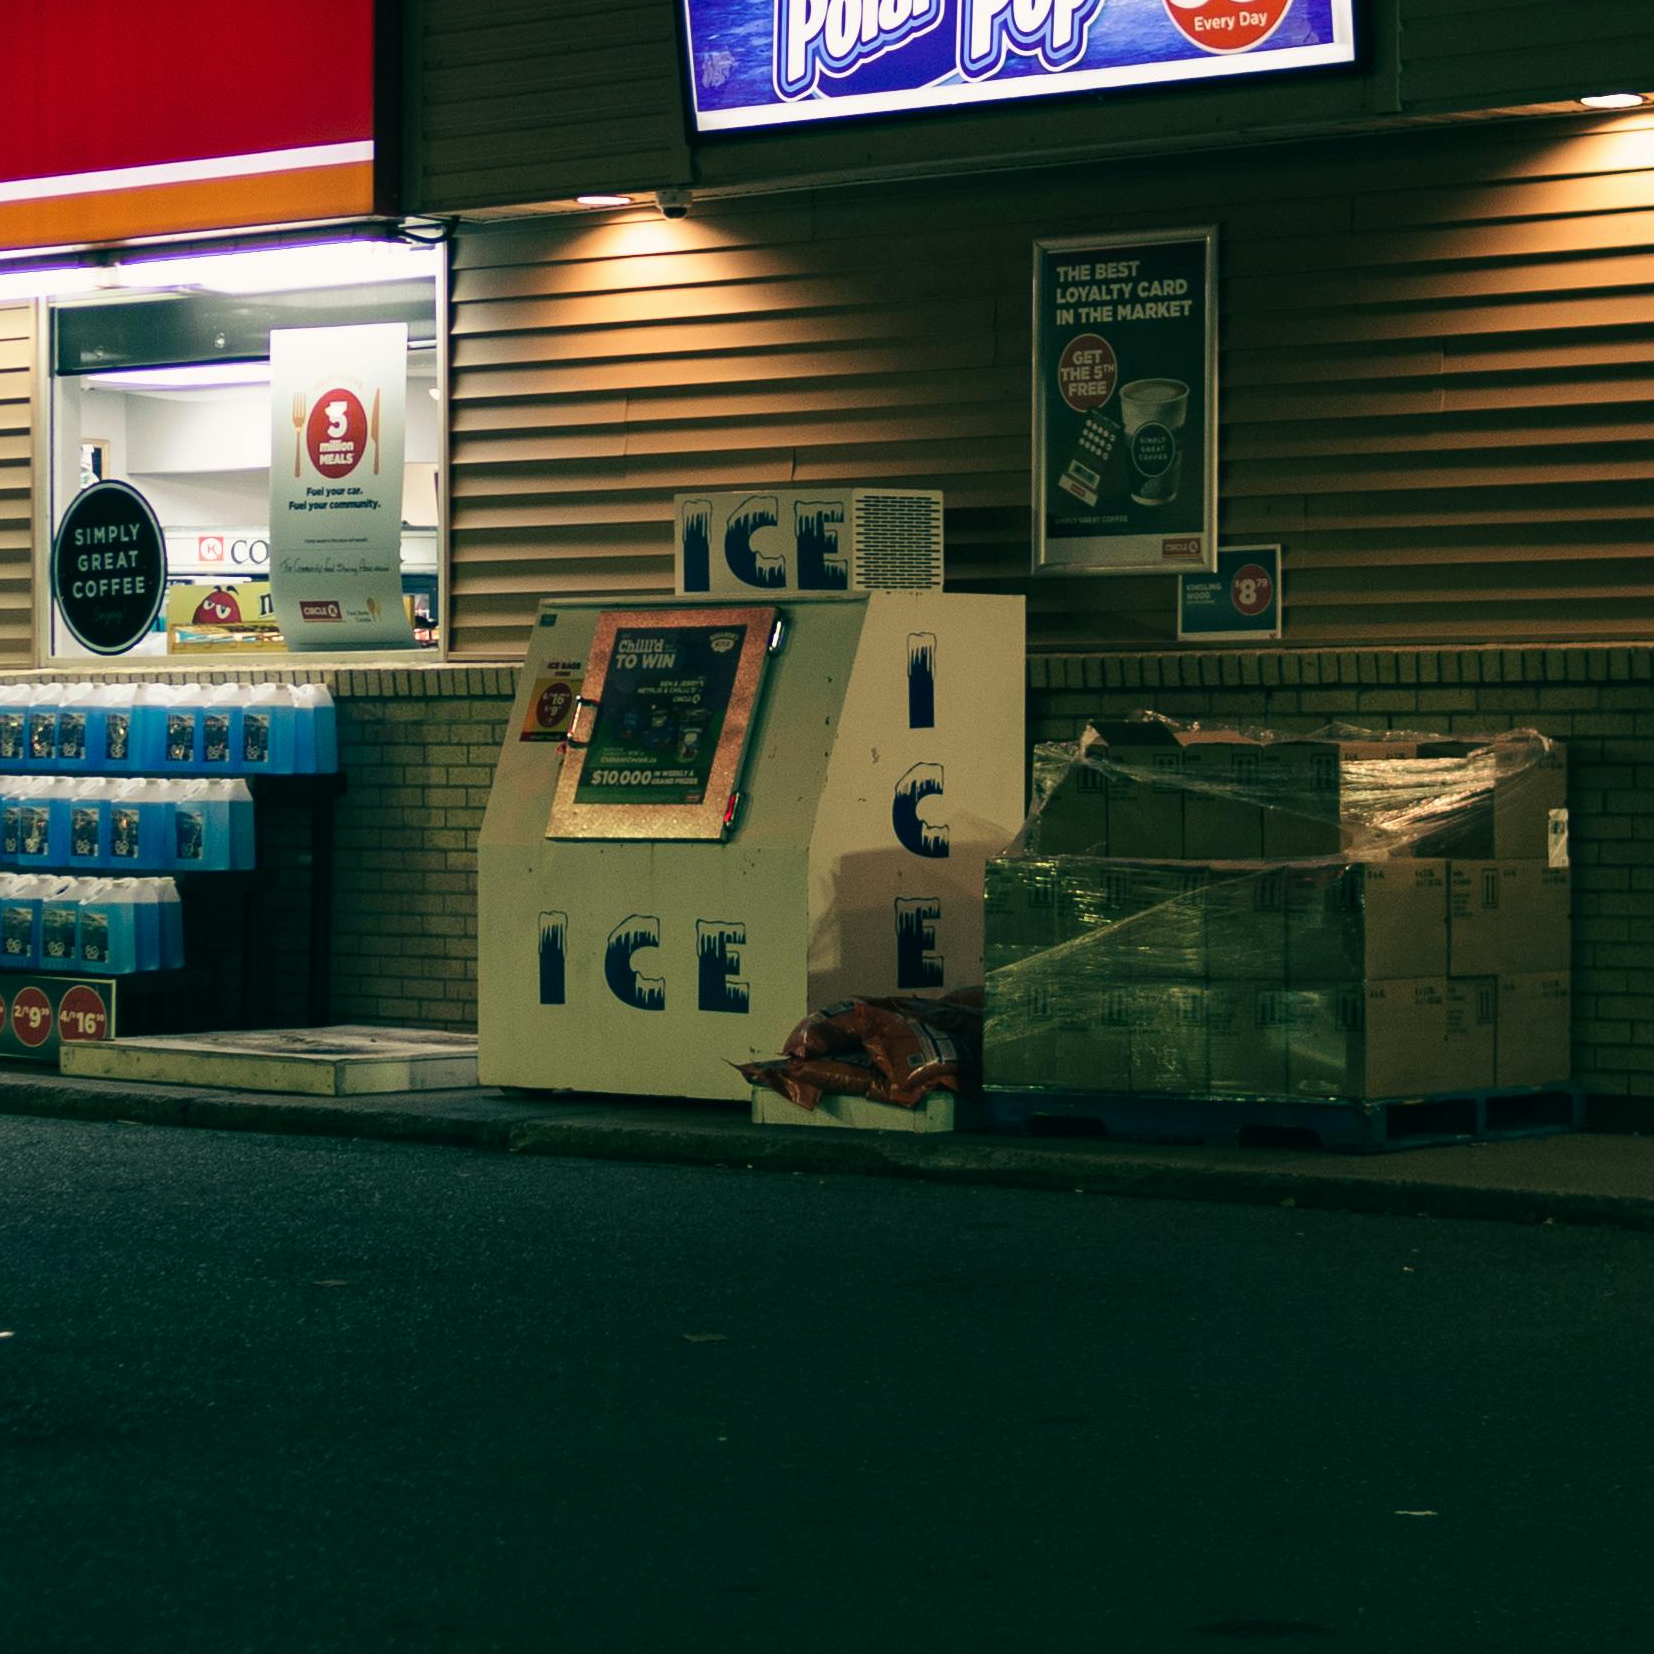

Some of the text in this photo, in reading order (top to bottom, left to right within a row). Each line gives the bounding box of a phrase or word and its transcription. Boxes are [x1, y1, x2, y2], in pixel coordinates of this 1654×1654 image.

[1193, 9, 1269, 34] Every Day
[1056, 261, 1141, 283] THE BEST
[1055, 279, 1188, 304] LOYALTY CARD
[1055, 300, 1193, 325] IN THE MARKET
[1072, 350, 1103, 366] GET
[1060, 366, 1091, 382] THE
[1067, 380, 1107, 397] FREE
[319, 440, 354, 454] million
[319, 453, 354, 466] MEALS
[306, 486, 363, 499] Fuel your car.
[288, 497, 382, 512] Fuel your community.
[74, 523, 141, 546] SIMPLY
[682, 495, 848, 593] ICE
[77, 550, 139, 572] GREAT
[71, 576, 145, 598] COFFEE
[616, 653, 676, 669] TO WIN
[591, 769, 652, 786] $10,000
[891, 631, 951, 990] ICE
[537, 910, 751, 1015] ICE
